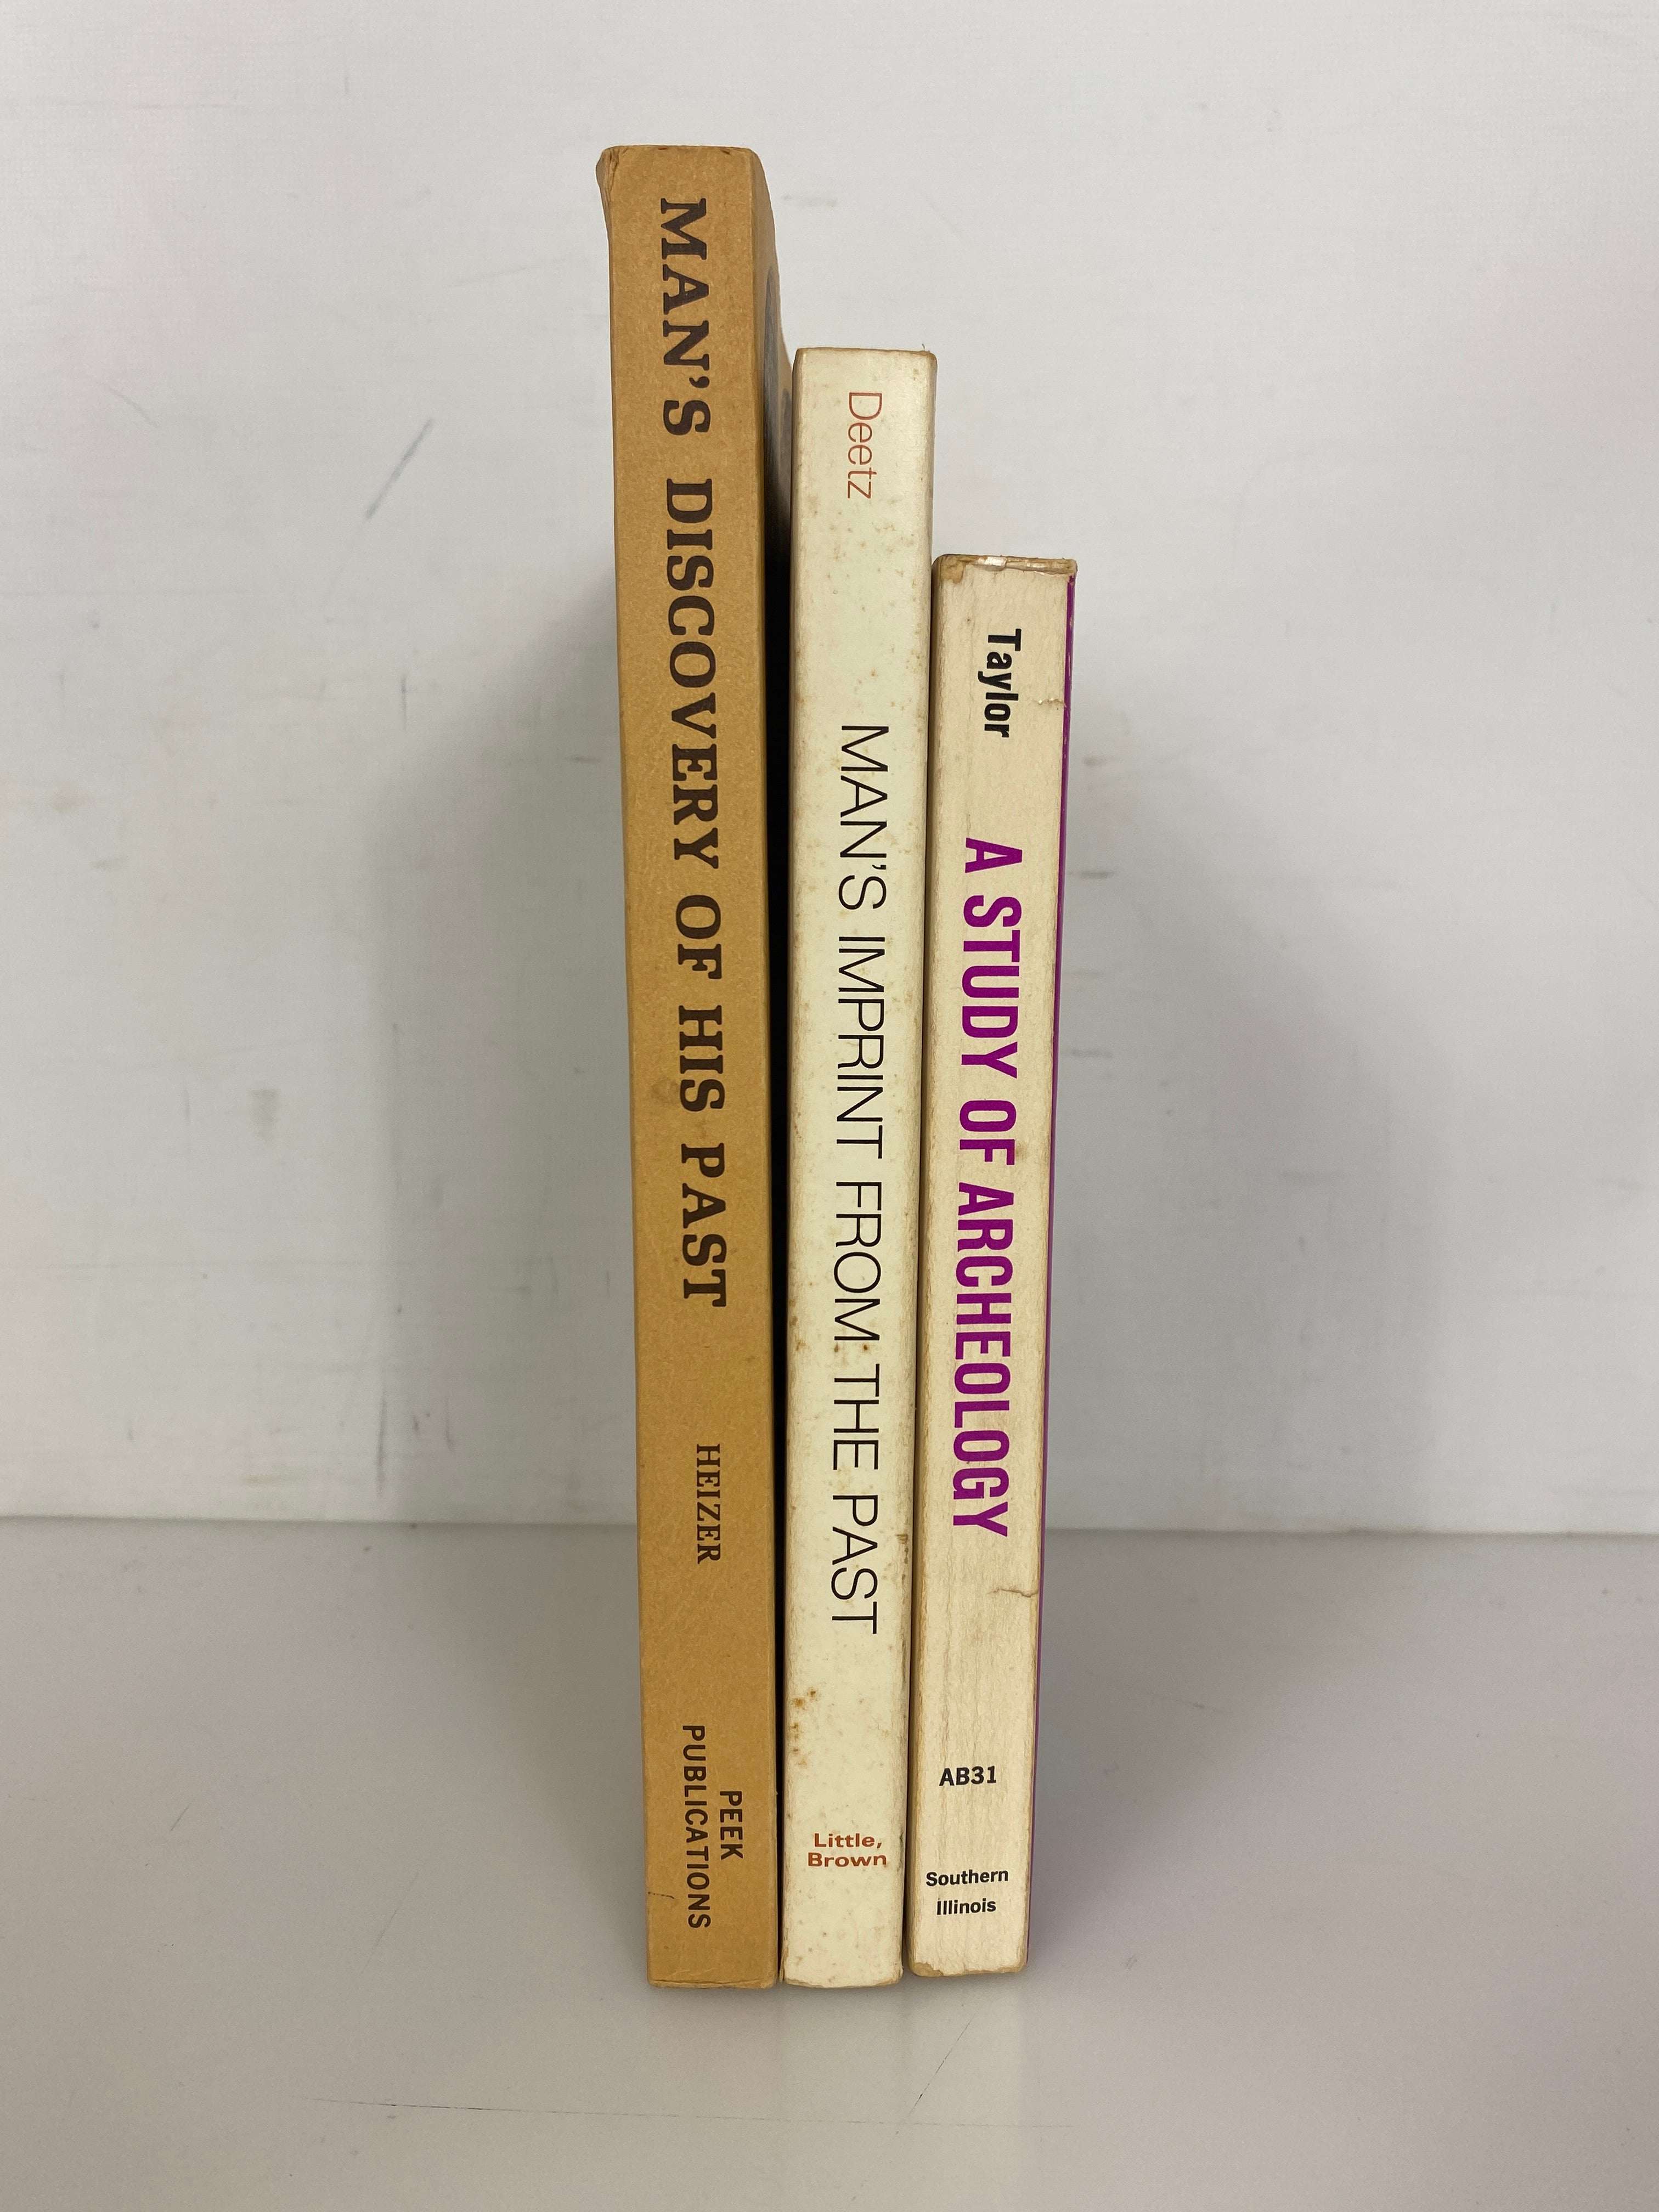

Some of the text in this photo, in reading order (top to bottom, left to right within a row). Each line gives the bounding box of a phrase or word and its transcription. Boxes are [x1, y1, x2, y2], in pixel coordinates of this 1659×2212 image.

[848, 392, 882, 498] Deetz
[978, 629, 1021, 737] Taylor
[661, 198, 726, 1307] MAN'S DISCOVERY OF HIS PAST
[831, 726, 889, 1634] MAN'S IMPRINT FROM THE PAST
[953, 838, 1022, 1536] A STUDY OF ARCHEOLOGY
[697, 1444, 720, 1564] HEIZER
[683, 1726, 711, 1928] PUBLICATIONS
[720, 1791, 743, 1859] PEEK
[939, 1766, 996, 1786] AB31
[808, 1853, 887, 1867] Brown
[815, 1833, 881, 1850] Little,
[927, 1870, 1008, 1886] Southern
[937, 1898, 996, 1915] Illinois
